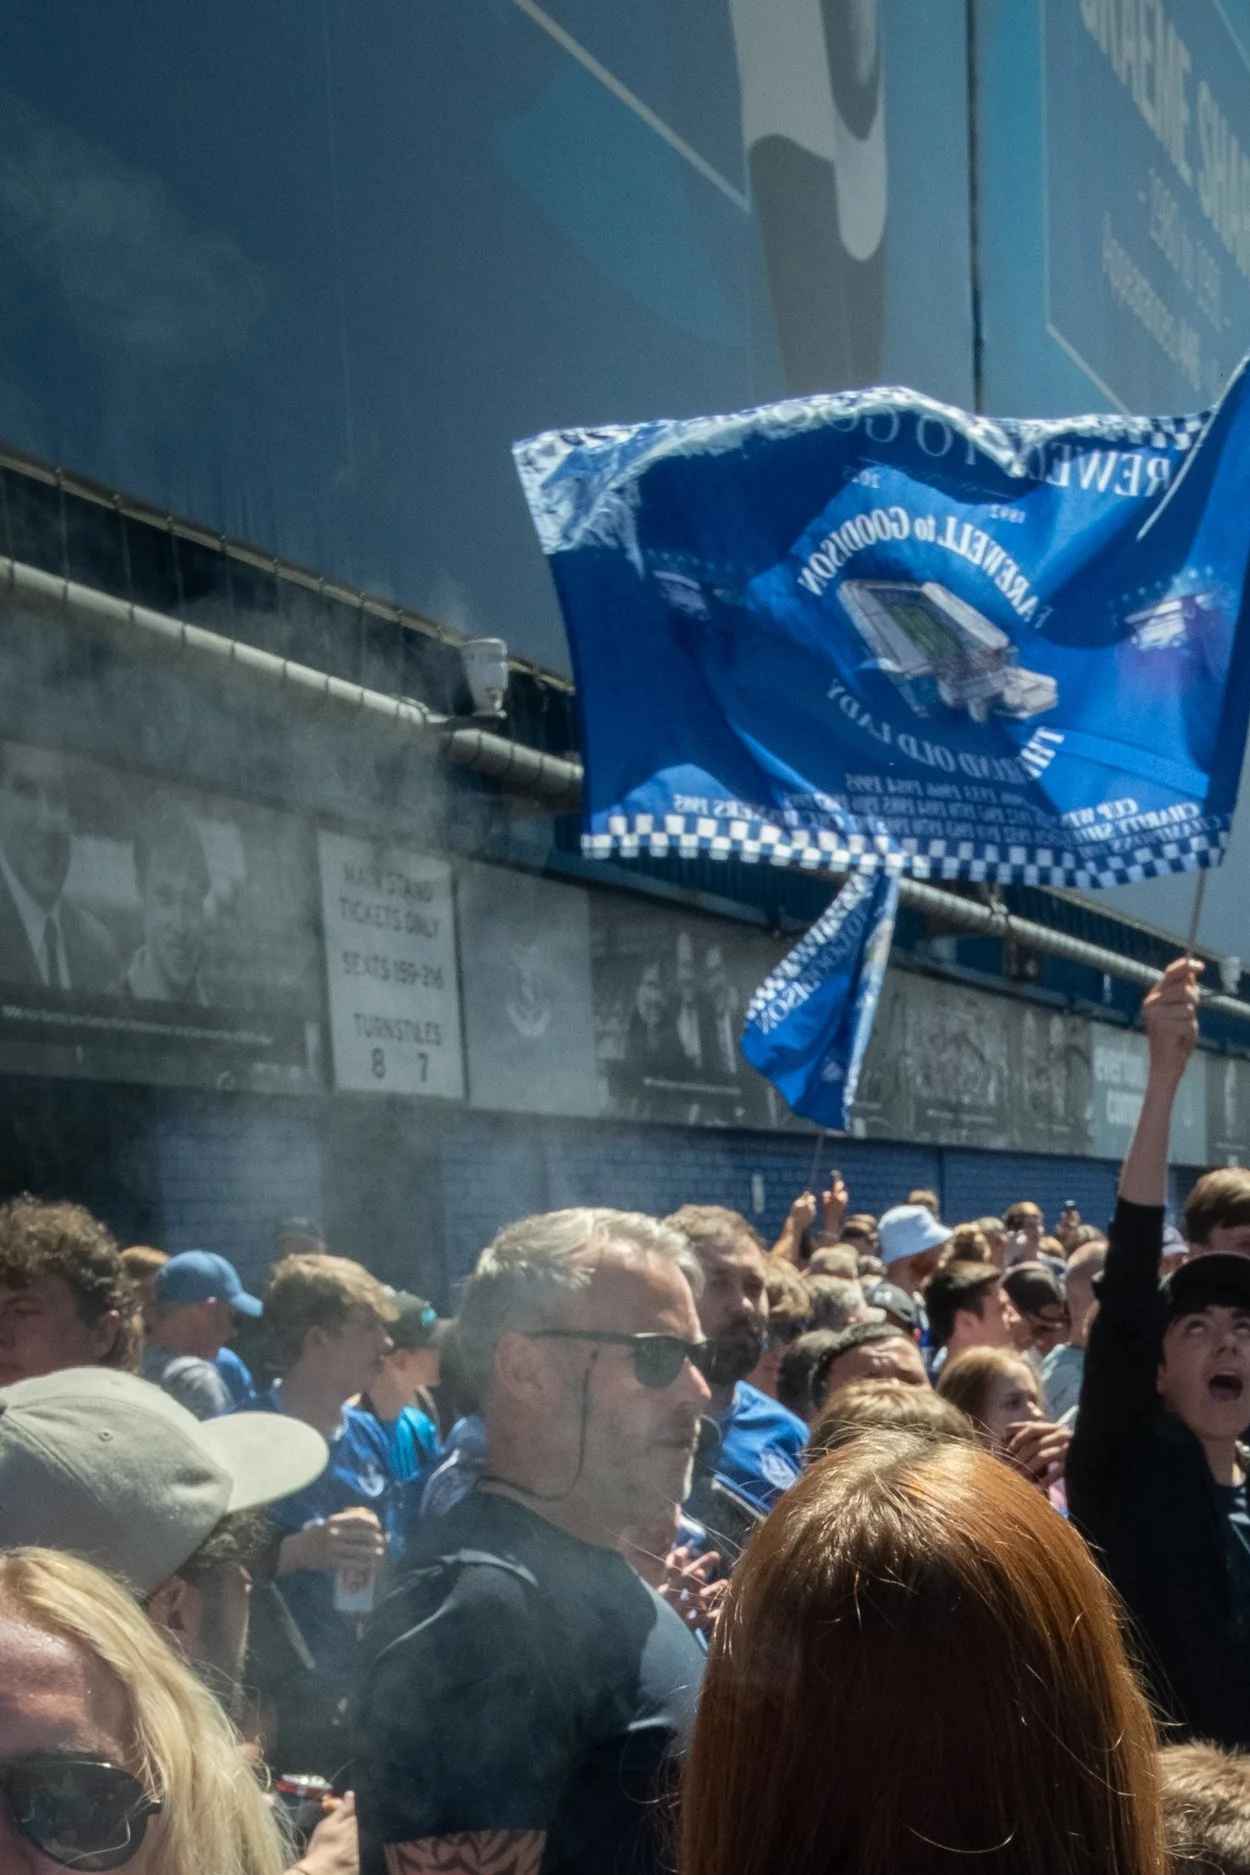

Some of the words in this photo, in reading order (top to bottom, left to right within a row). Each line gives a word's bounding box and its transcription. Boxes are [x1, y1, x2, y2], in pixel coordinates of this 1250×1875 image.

[339, 896, 403, 932] TICKETS
[352, 1012, 443, 1047] TURNSTILES
[370, 1047, 387, 1080] 8
[416, 1051, 430, 1084] 7
